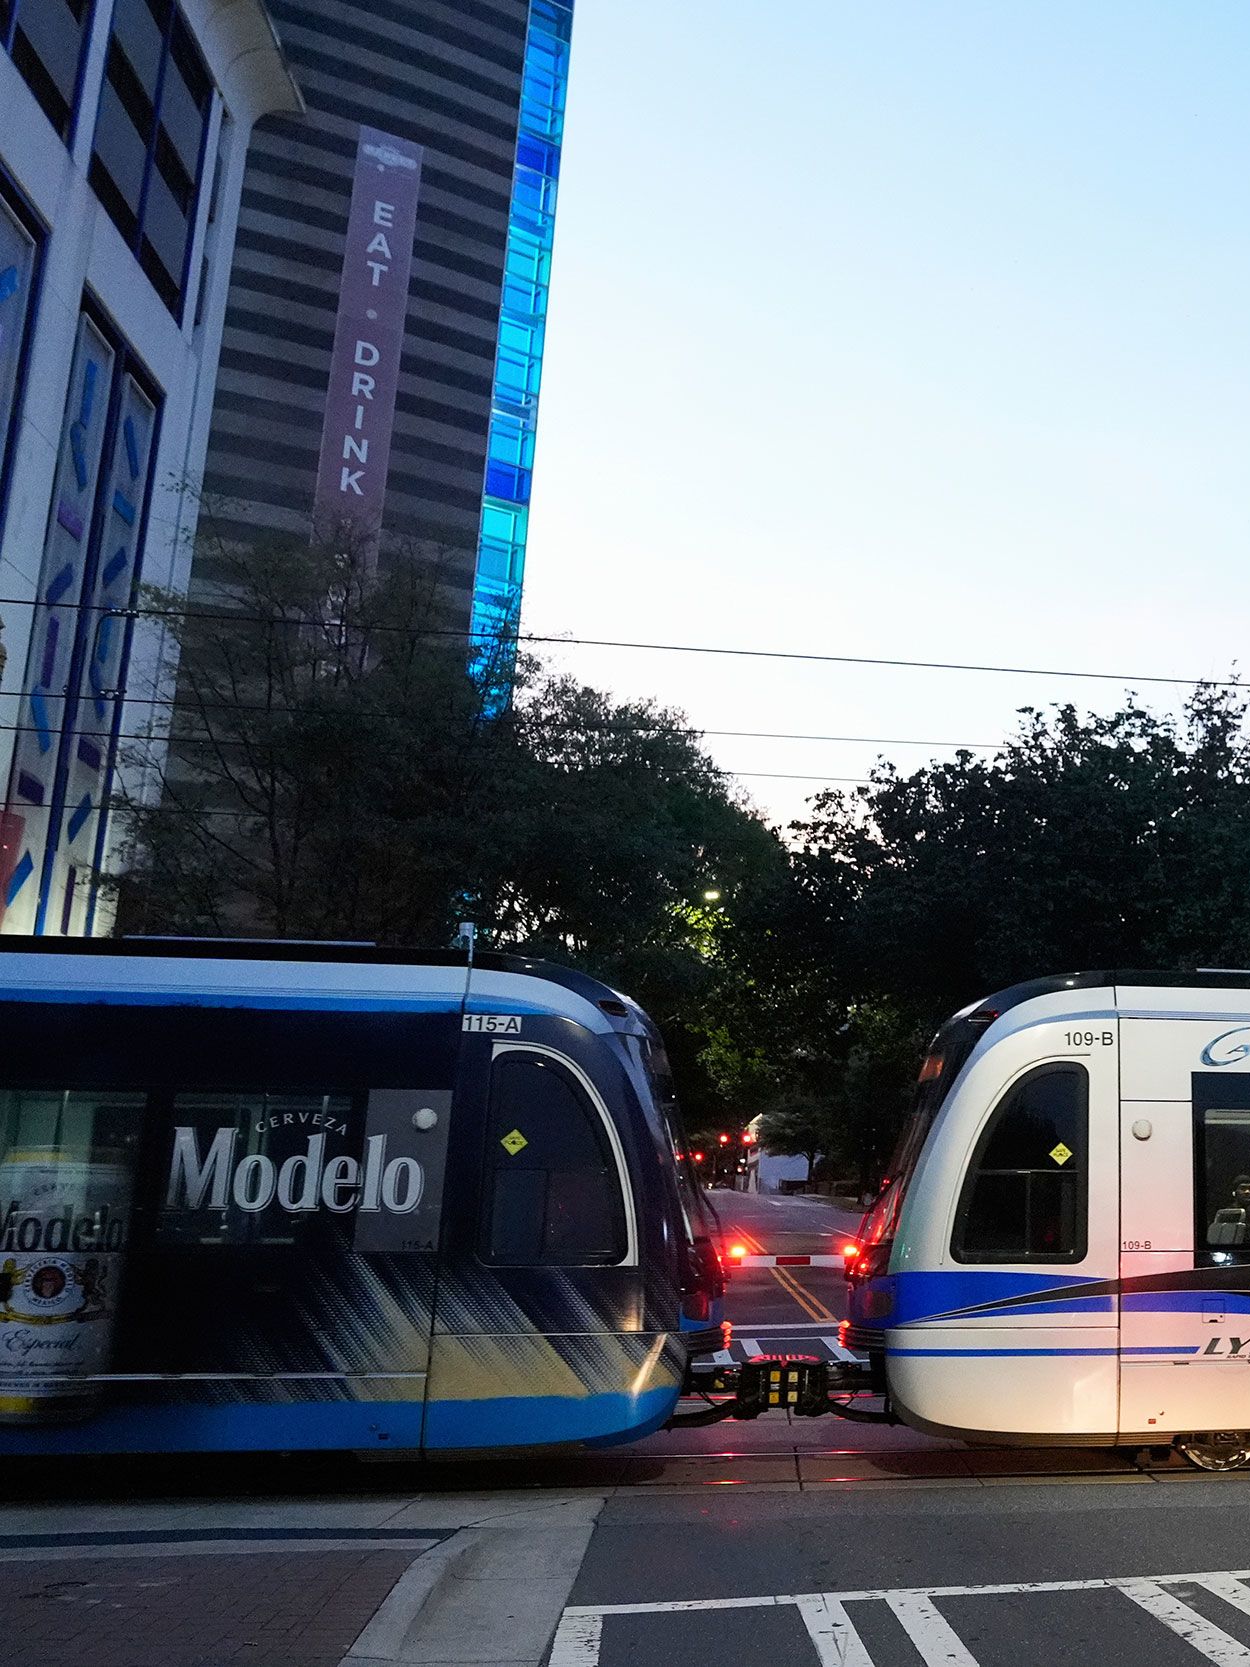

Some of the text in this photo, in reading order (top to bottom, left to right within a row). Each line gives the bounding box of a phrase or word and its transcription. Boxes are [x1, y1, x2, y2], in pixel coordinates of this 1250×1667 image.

[366, 200, 396, 288] EAT
[340, 340, 381, 496] DRINK
[464, 1015, 519, 1033] 115-A
[1064, 1031, 1114, 1046] 109-B
[255, 1112, 347, 1136] CERVEZA
[166, 1126, 426, 1215] Modelo
[1122, 1240, 1152, 1250] 109-B
